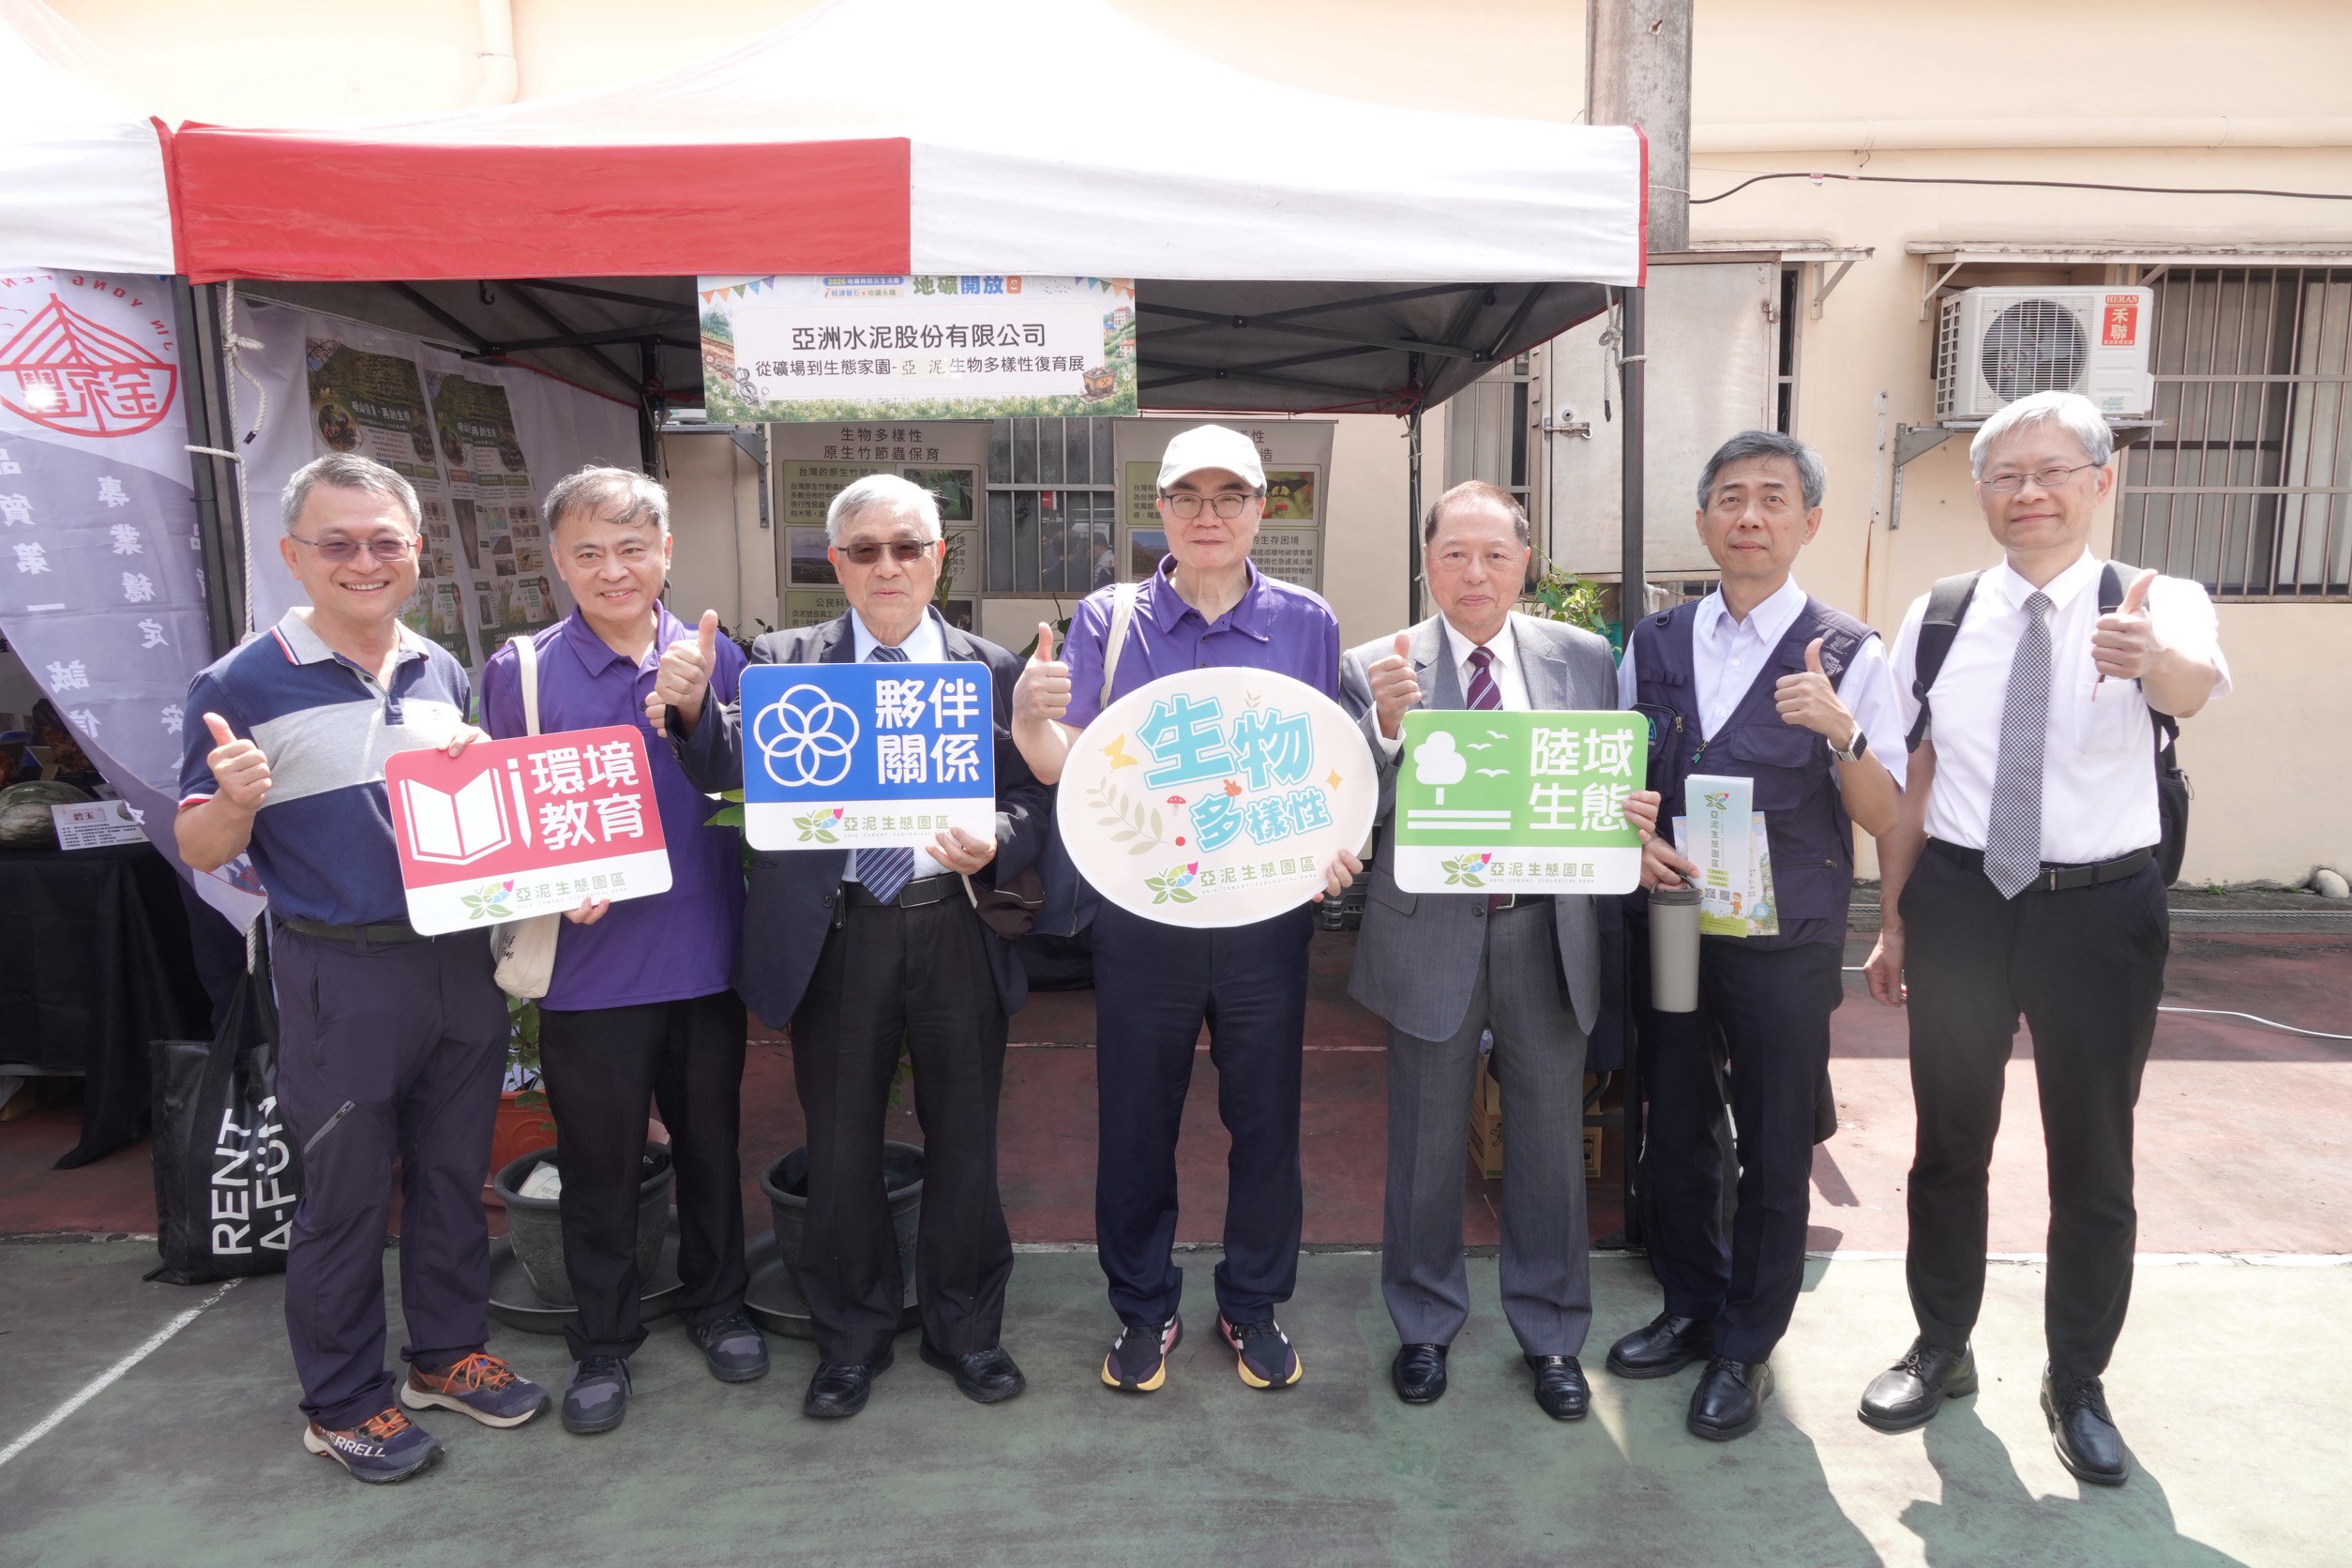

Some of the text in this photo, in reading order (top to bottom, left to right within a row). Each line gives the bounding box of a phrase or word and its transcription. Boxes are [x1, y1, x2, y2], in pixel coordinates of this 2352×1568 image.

[792, 324, 1046, 350] 亞洲水泥股份有限公司
[2110, 308, 2129, 339] 禾聯
[823, 445, 940, 461] 原生竹節蟲保育
[840, 428, 923, 443] 生物多樣性
[875, 677, 979, 729] 夥伴
[877, 733, 980, 785] 關係
[1136, 693, 1314, 792] 生物
[1530, 728, 1635, 777] 陸域
[527, 740, 640, 796] 環境
[539, 793, 644, 851] 教育
[844, 815, 950, 831] 亞泥生態園區
[1190, 786, 1333, 853] 多樣性
[1529, 782, 1631, 832] 生態
[515, 871, 626, 903] 亞泥生態園區
[1200, 856, 1317, 887] 亞泥生態園區
[1490, 862, 1595, 877] 亞泥生態園區
[211, 1108, 252, 1255] RENT
